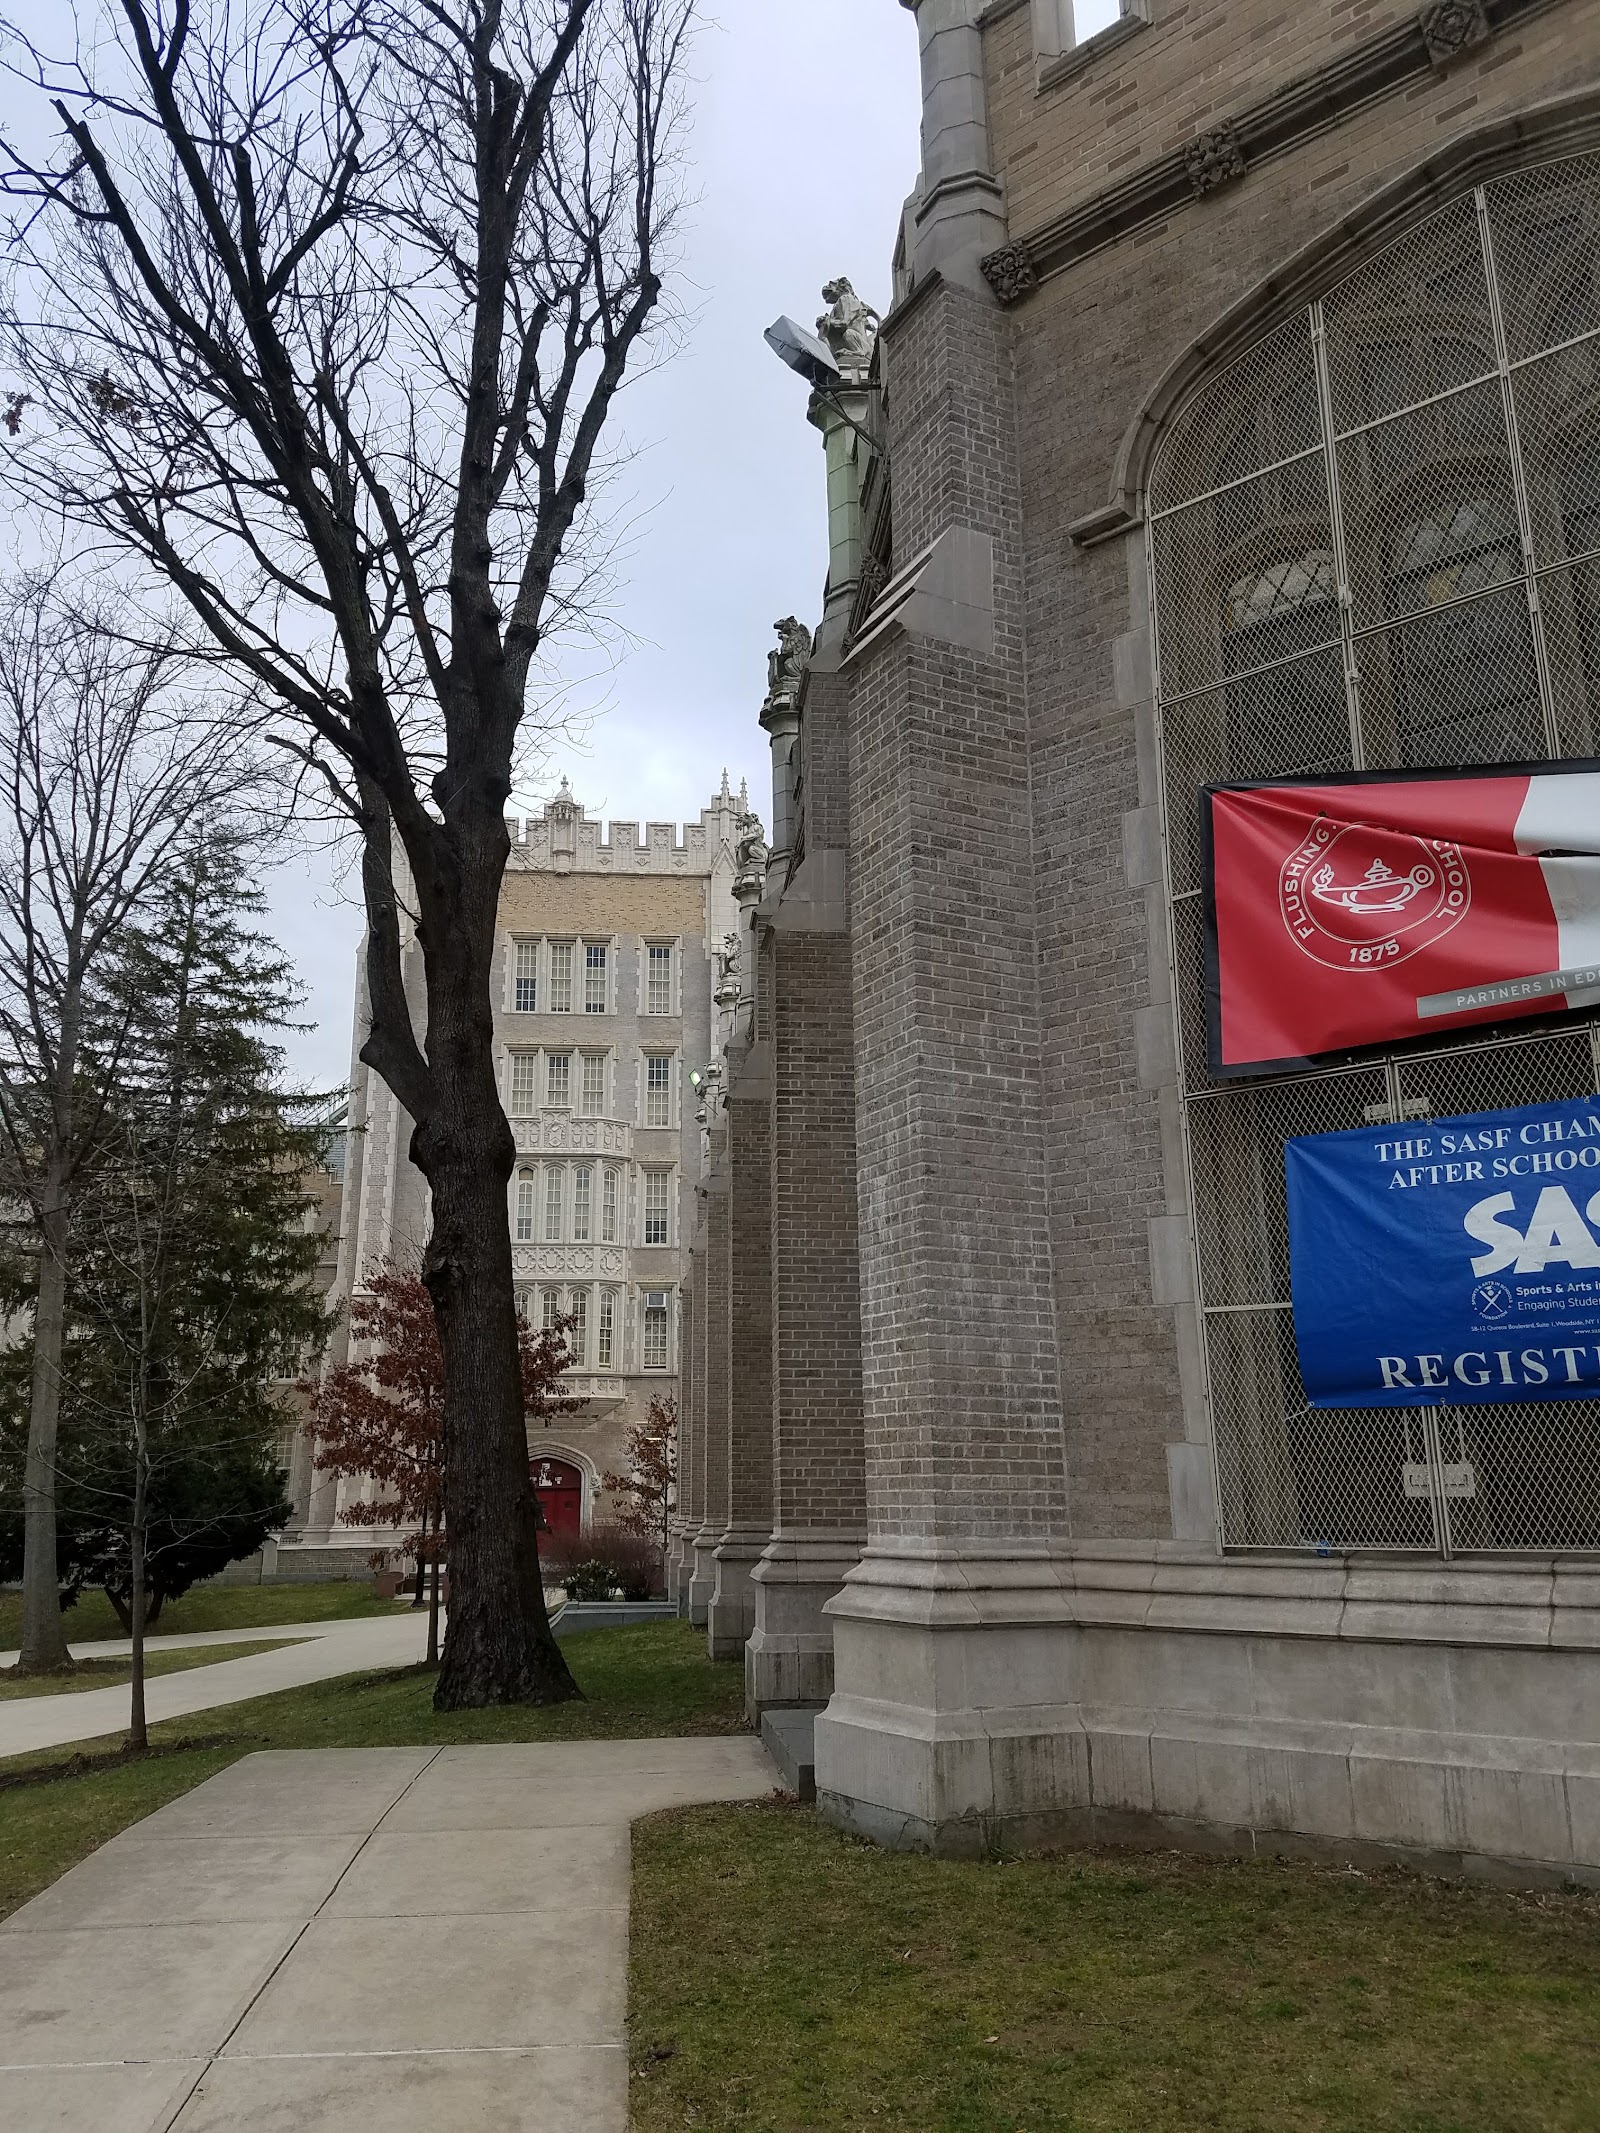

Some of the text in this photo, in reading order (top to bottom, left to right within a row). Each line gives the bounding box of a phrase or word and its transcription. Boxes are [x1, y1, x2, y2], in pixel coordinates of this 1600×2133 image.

[1285, 828, 1464, 940] FLUSHING CHOOL
[1349, 938, 1400, 963] 1875
[1456, 969, 1600, 1007] PARTNERS IN ED
[1374, 1138, 1433, 1163] THE
[1441, 1127, 1511, 1155] SASF
[1387, 1161, 1485, 1190] AFTER
[1463, 1185, 1600, 1279] SA
[1516, 1280, 1600, 1297] Sports & Arts i
[1517, 1297, 1600, 1312] Engaging Stude
[1376, 1346, 1600, 1389] REGIST
